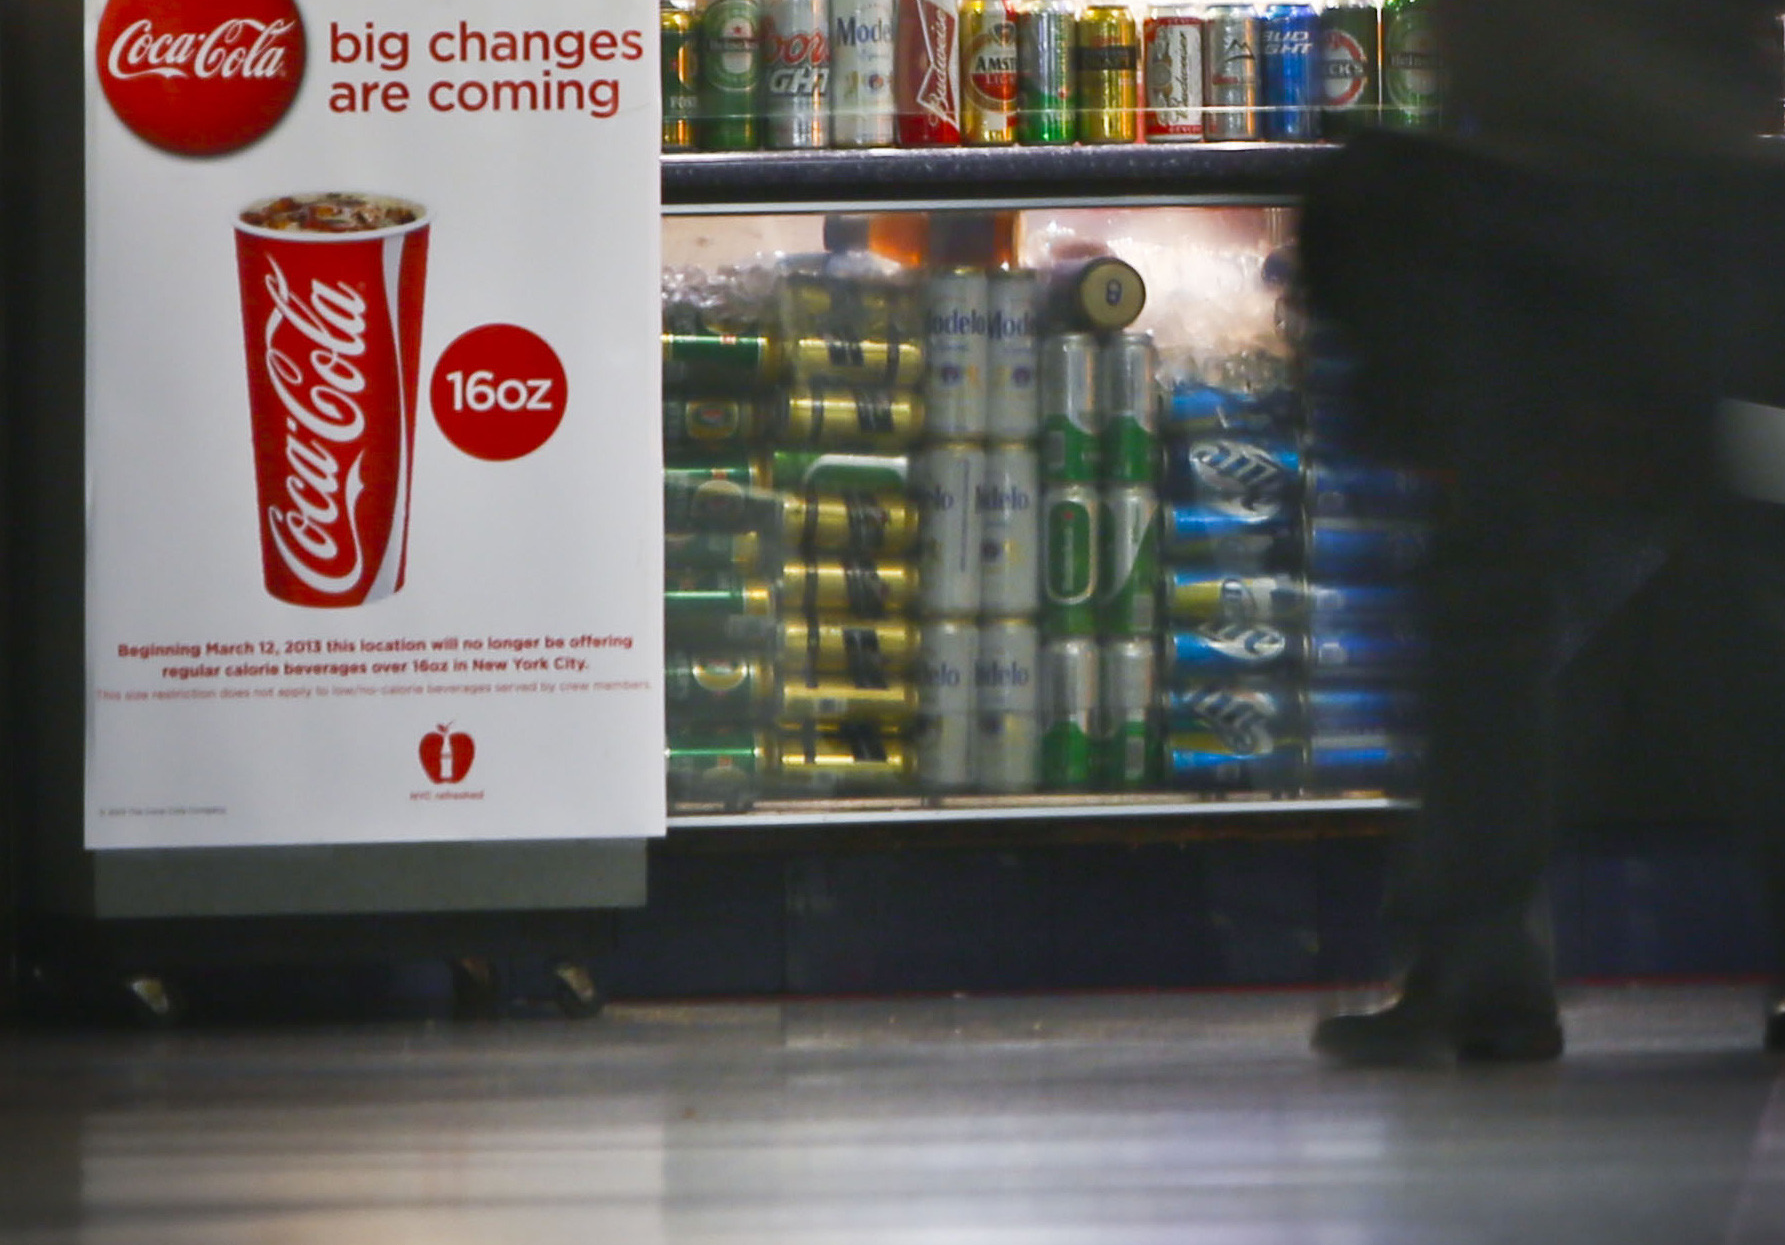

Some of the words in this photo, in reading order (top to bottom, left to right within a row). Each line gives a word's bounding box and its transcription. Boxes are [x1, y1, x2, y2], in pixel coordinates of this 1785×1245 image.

[107, 17, 296, 80] Coca-Cola
[330, 22, 409, 72] big
[429, 21, 644, 71] changes
[836, 15, 893, 47] Mode
[976, 56, 1017, 73] AMST
[329, 81, 410, 114] are
[429, 71, 620, 119] coming
[446, 369, 554, 412] 16oz
[264, 254, 367, 595] Coca-Cola
[117, 643, 202, 659] Beginning
[206, 640, 255, 655] March
[259, 641, 280, 656] 12,
[284, 640, 322, 654] 2013
[326, 640, 356, 653] this
[360, 638, 427, 653] location
[431, 637, 459, 651] will
[463, 640, 484, 651] no
[488, 636, 540, 653] longer
[545, 636, 566, 650] be
[569, 634, 634, 650] offering
[162, 664, 221, 680] regular
[225, 664, 280, 677] calorie
[284, 663, 368, 678] beverages
[372, 663, 407, 674] over
[414, 660, 448, 674] 16oz
[453, 659, 469, 672] in
[472, 659, 509, 672] New
[514, 657, 549, 671] York
[554, 656, 589, 673] City.
